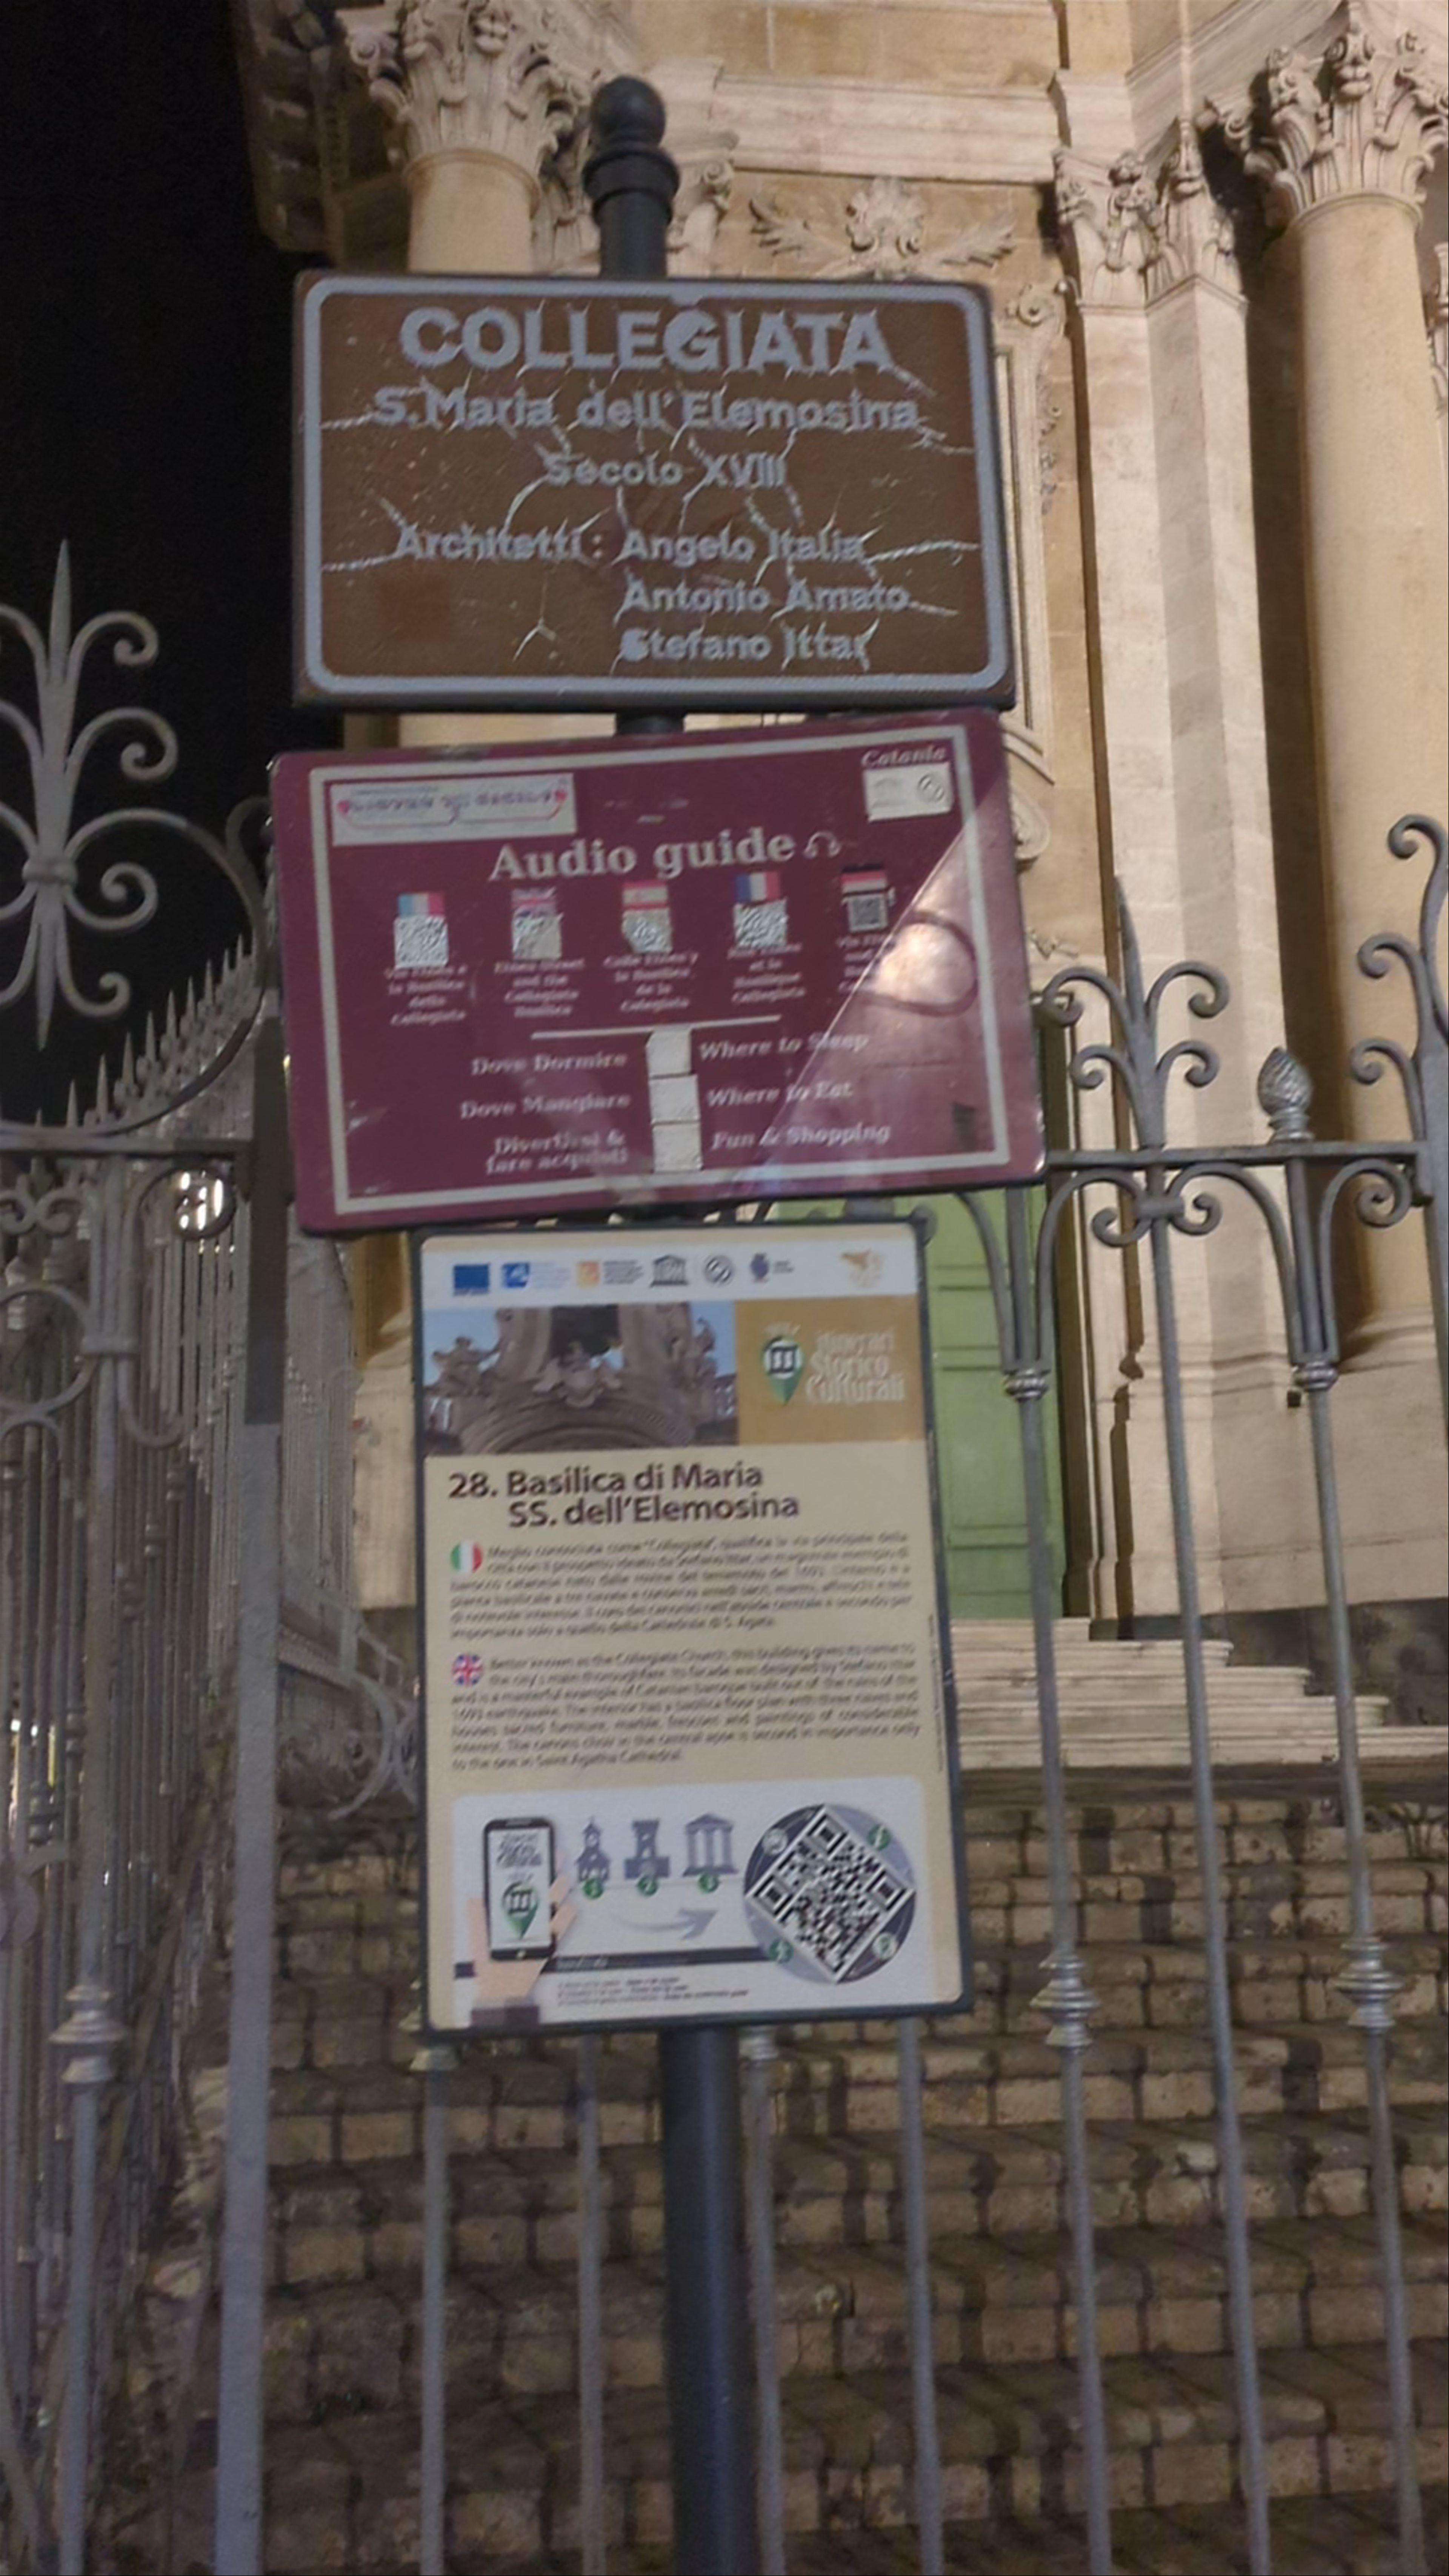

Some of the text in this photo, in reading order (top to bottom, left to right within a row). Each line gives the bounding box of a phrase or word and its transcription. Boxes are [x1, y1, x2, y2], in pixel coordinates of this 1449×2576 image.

[399, 306, 895, 374] COLLEGIATA
[577, 389, 917, 431] dell'Elemosina
[546, 453, 787, 489] Secolo XVIII
[623, 529, 755, 567] Angelo
[768, 528, 864, 561] Italia
[625, 579, 912, 612] Antonio Amato
[621, 626, 870, 662] Stefano Ittar
[489, 827, 795, 882] Audio guide
[471, 1050, 627, 1076] Dove Dormire
[701, 1038, 774, 1062] Where
[779, 1033, 801, 1053] to
[460, 1093, 630, 1121] Dove Mangiare
[707, 1081, 853, 1109] Where to Eat
[608, 1130, 626, 1149] &
[712, 1123, 891, 1151] Fun & Shopping
[485, 1154, 535, 1177] fare
[448, 1459, 763, 1501] 28. Basilica di Maria
[509, 1490, 800, 1528] SS. dell'Elemosina
